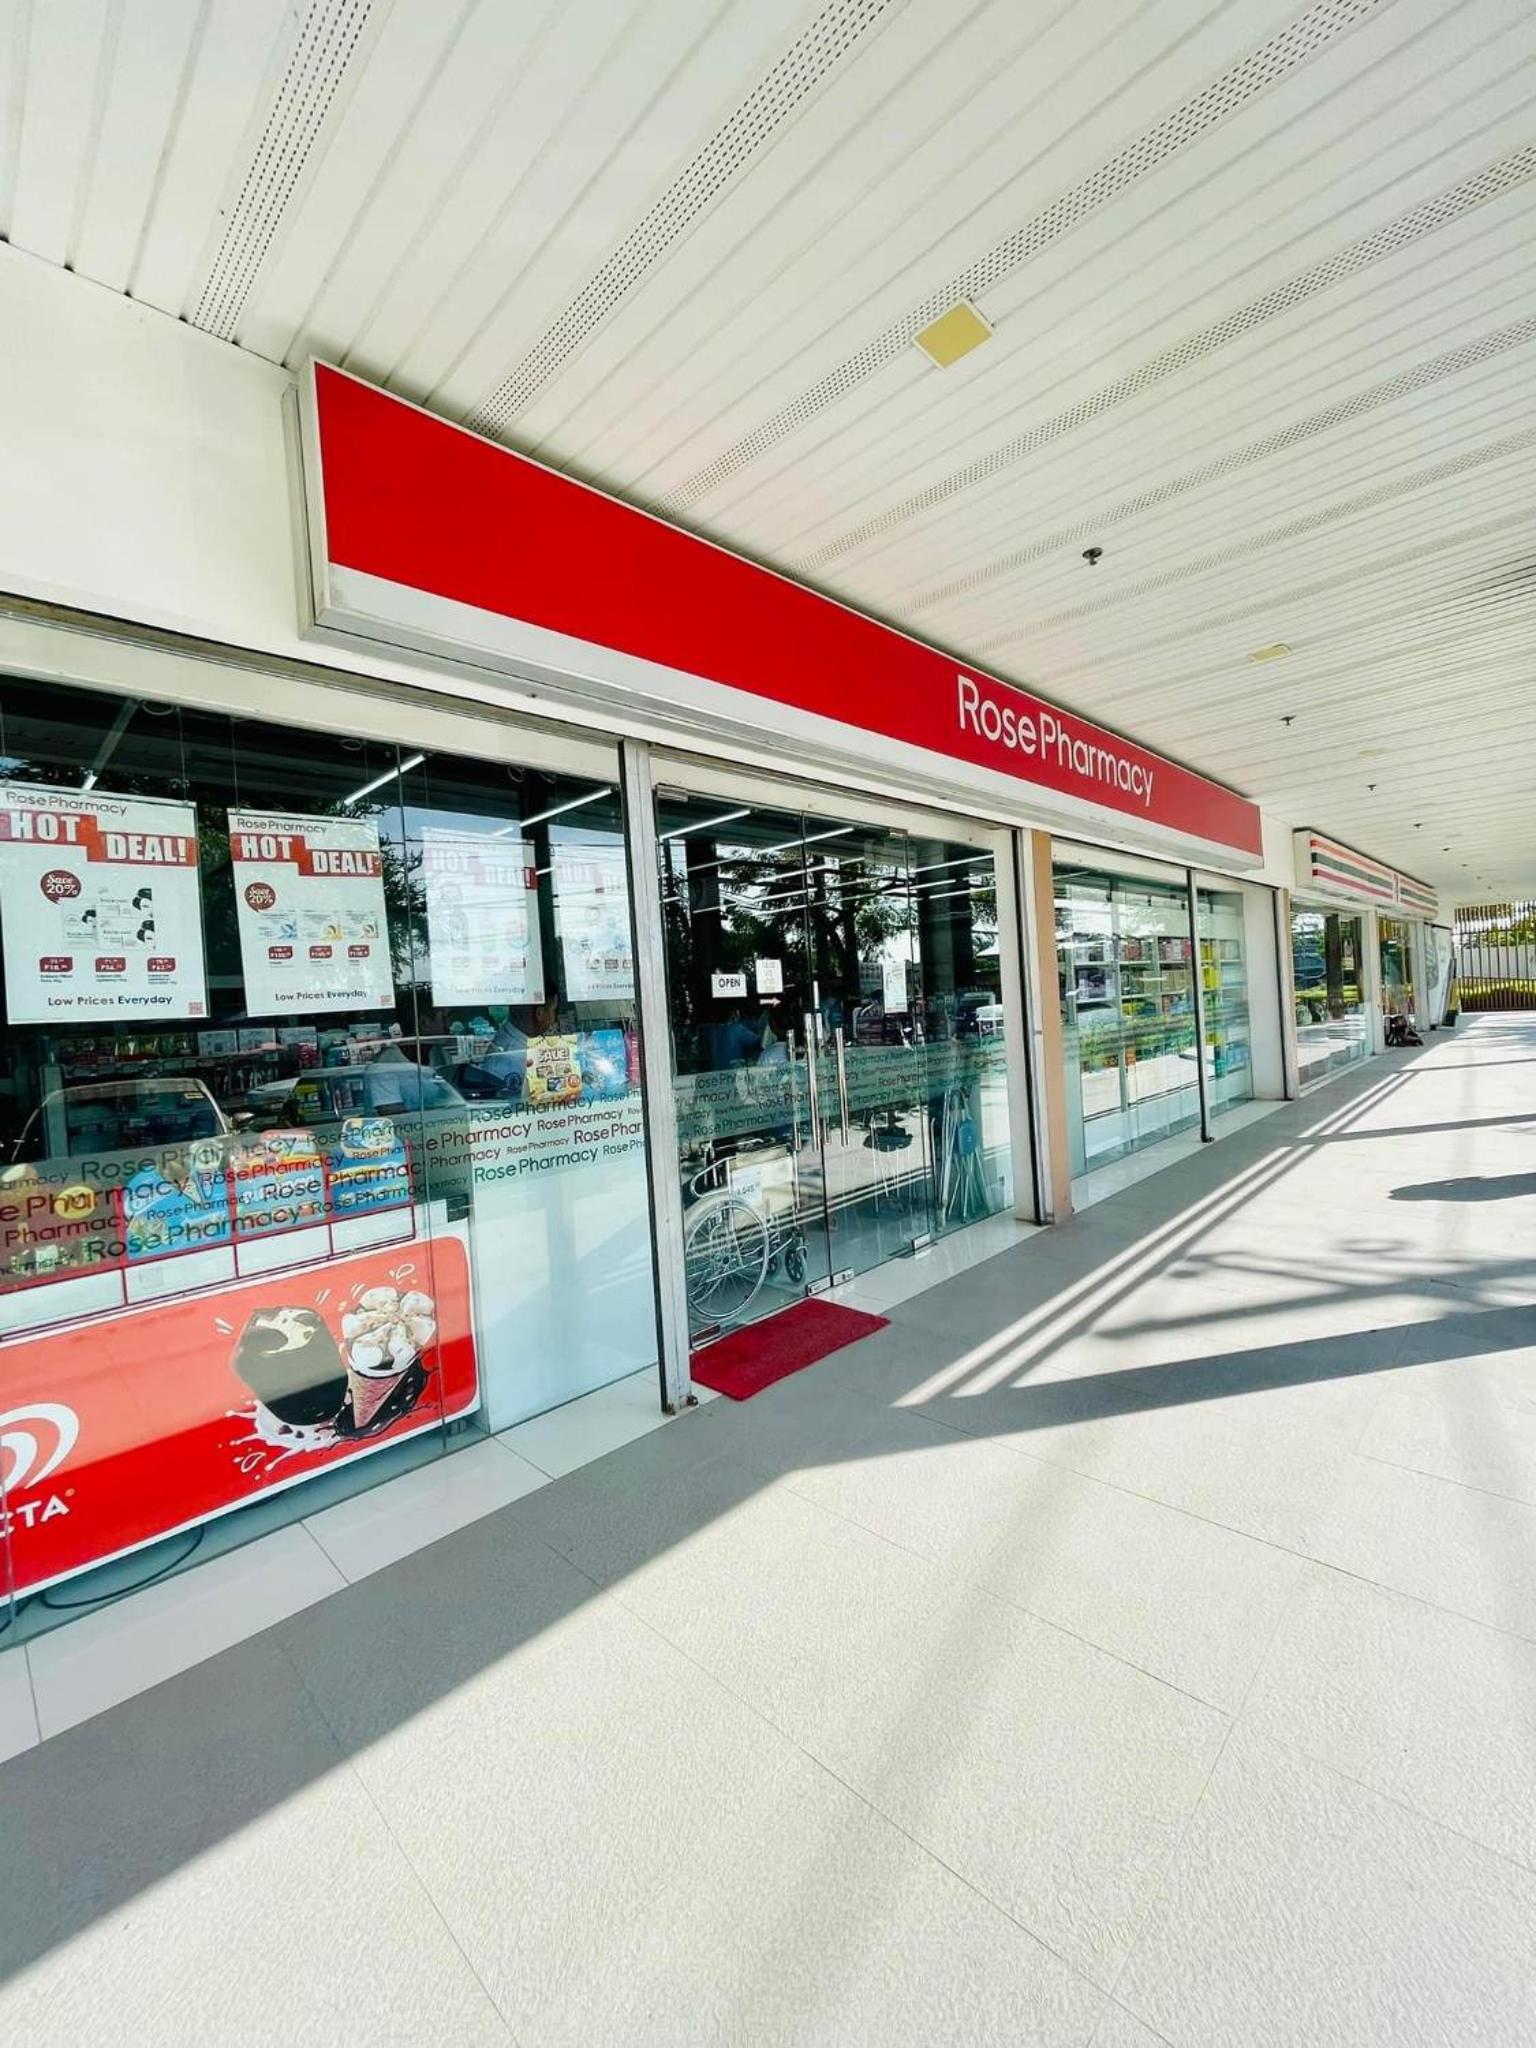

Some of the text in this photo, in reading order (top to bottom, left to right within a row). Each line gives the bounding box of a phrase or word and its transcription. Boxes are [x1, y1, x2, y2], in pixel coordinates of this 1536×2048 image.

[957, 674, 1153, 807] Rose Pharmacy
[6, 791, 128, 817] Rose Pharmacy
[10, 810, 187, 863] HOT DEAL!
[237, 817, 327, 835] Rose Pharmacy
[240, 835, 374, 874] HOT DEAL!
[47, 884, 79, 896] 20%
[48, 994, 173, 1007] Low Prices Everyday
[275, 989, 368, 1001] Low Prices Everyday
[718, 978, 741, 989] OPEN
[470, 1105, 513, 1124] Rose
[515, 1094, 594, 1118] Pharmacy
[693, 1116, 721, 1136] Rose
[441, 1123, 532, 1149] Pharmacy
[537, 1118, 566, 1132] Rose
[568, 1107, 623, 1126] Pharmacy
[430, 1147, 501, 1169] Pharmacy
[529, 1137, 570, 1151] Pharmacy
[574, 1128, 610, 1145] Rose
[474, 1164, 516, 1184] Rose
[519, 1147, 598, 1174] Pharmacy
[603, 1143, 629, 1156] Rose
[27, 1175, 190, 1219] Pharmacy
[252, 1151, 345, 1180] Pharmacy
[82, 1158, 156, 1182] Rose
[6, 1212, 134, 1248] Pharmacy
[147, 1206, 183, 1221] Rose
[263, 1179, 321, 1202] Rose
[86, 1233, 162, 1262] Rose
[166, 1205, 300, 1247] Pharmacy
